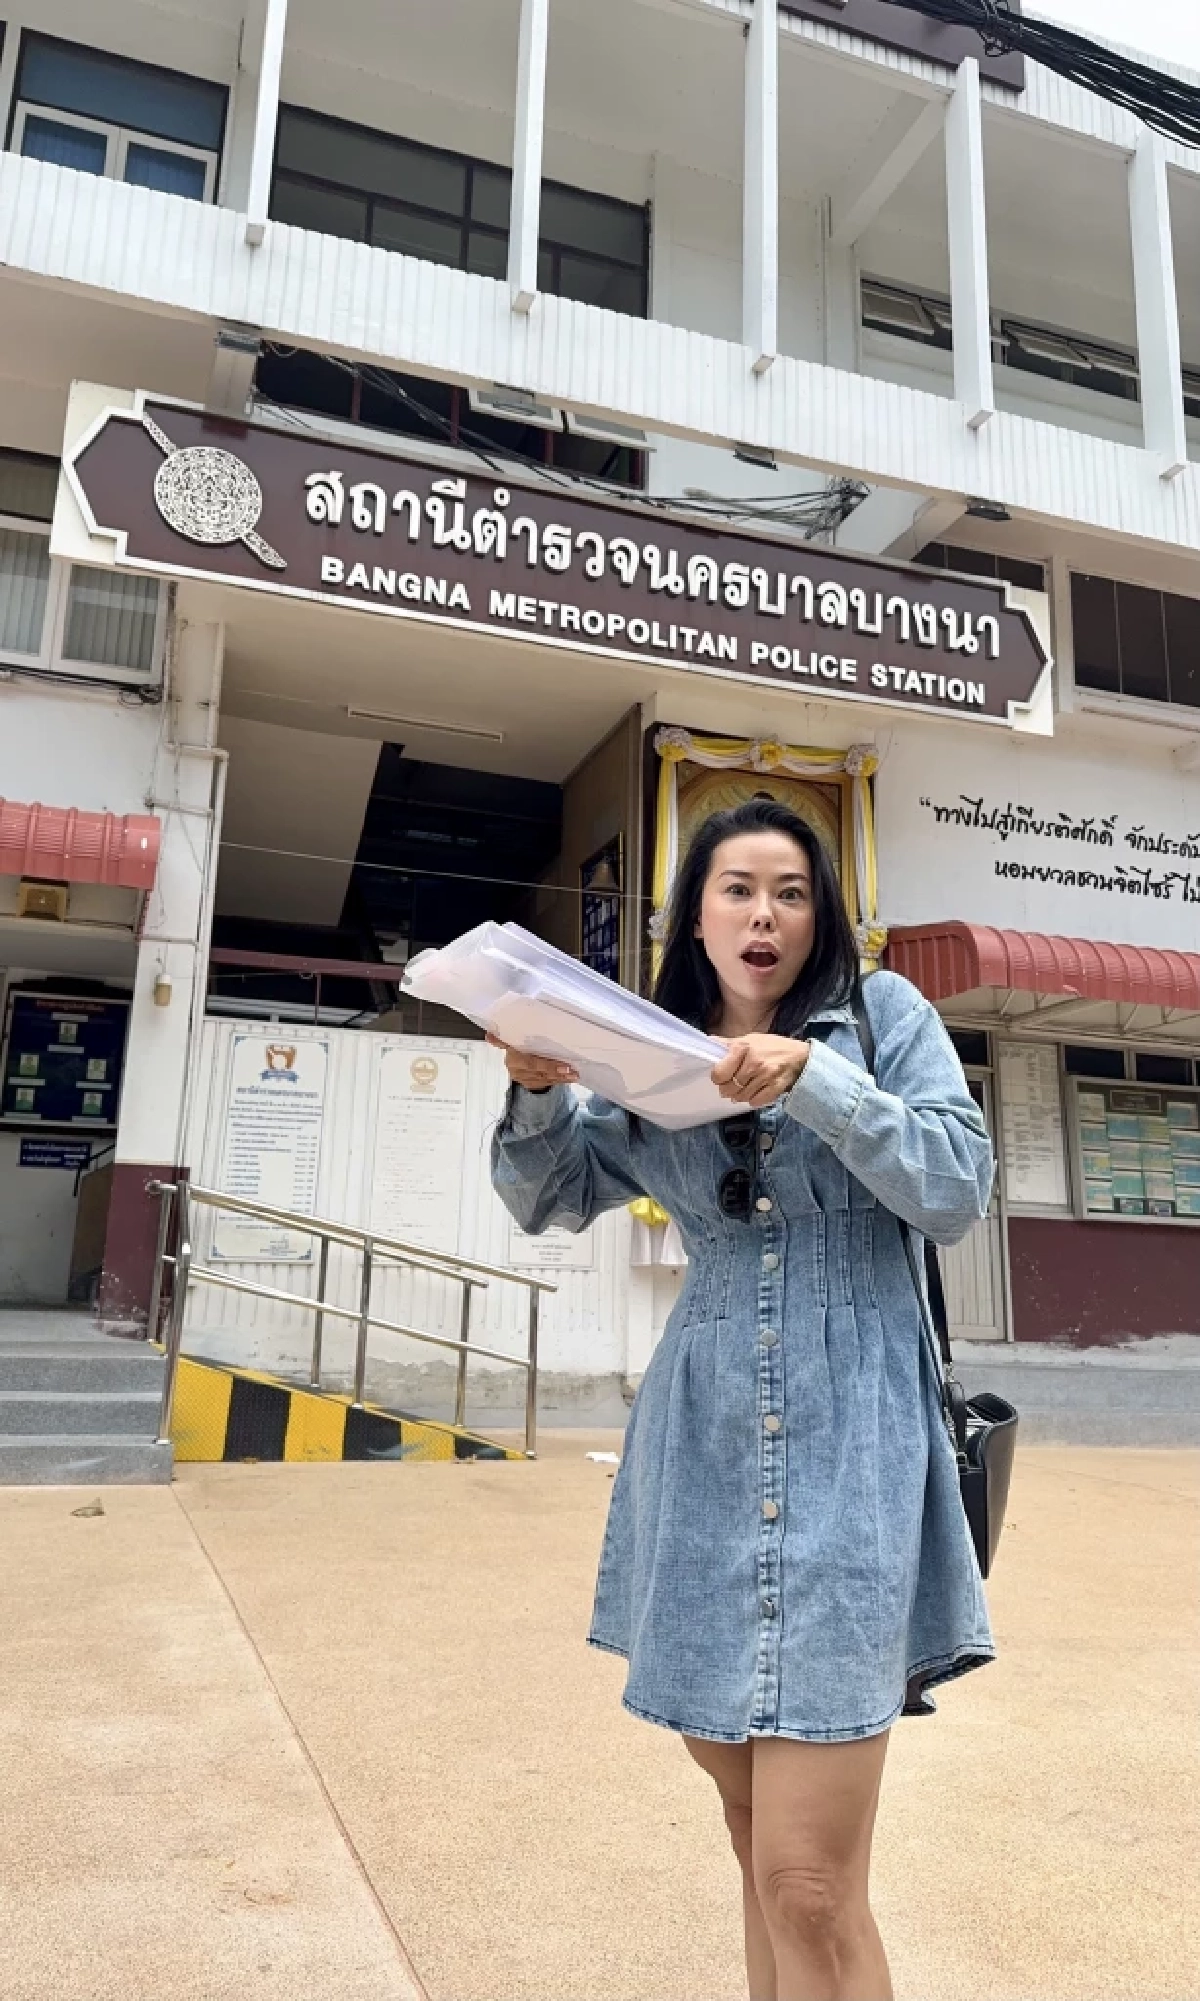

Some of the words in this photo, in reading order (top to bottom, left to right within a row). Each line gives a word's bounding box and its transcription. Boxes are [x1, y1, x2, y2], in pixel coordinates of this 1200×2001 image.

[304, 470, 1000, 658] สถานีตำรวจนครบาลบางนา
[321, 555, 471, 611] BANGNA
[489, 590, 738, 660] METROPOLITAN
[751, 641, 858, 682] POLICE
[871, 663, 985, 705] STATION
